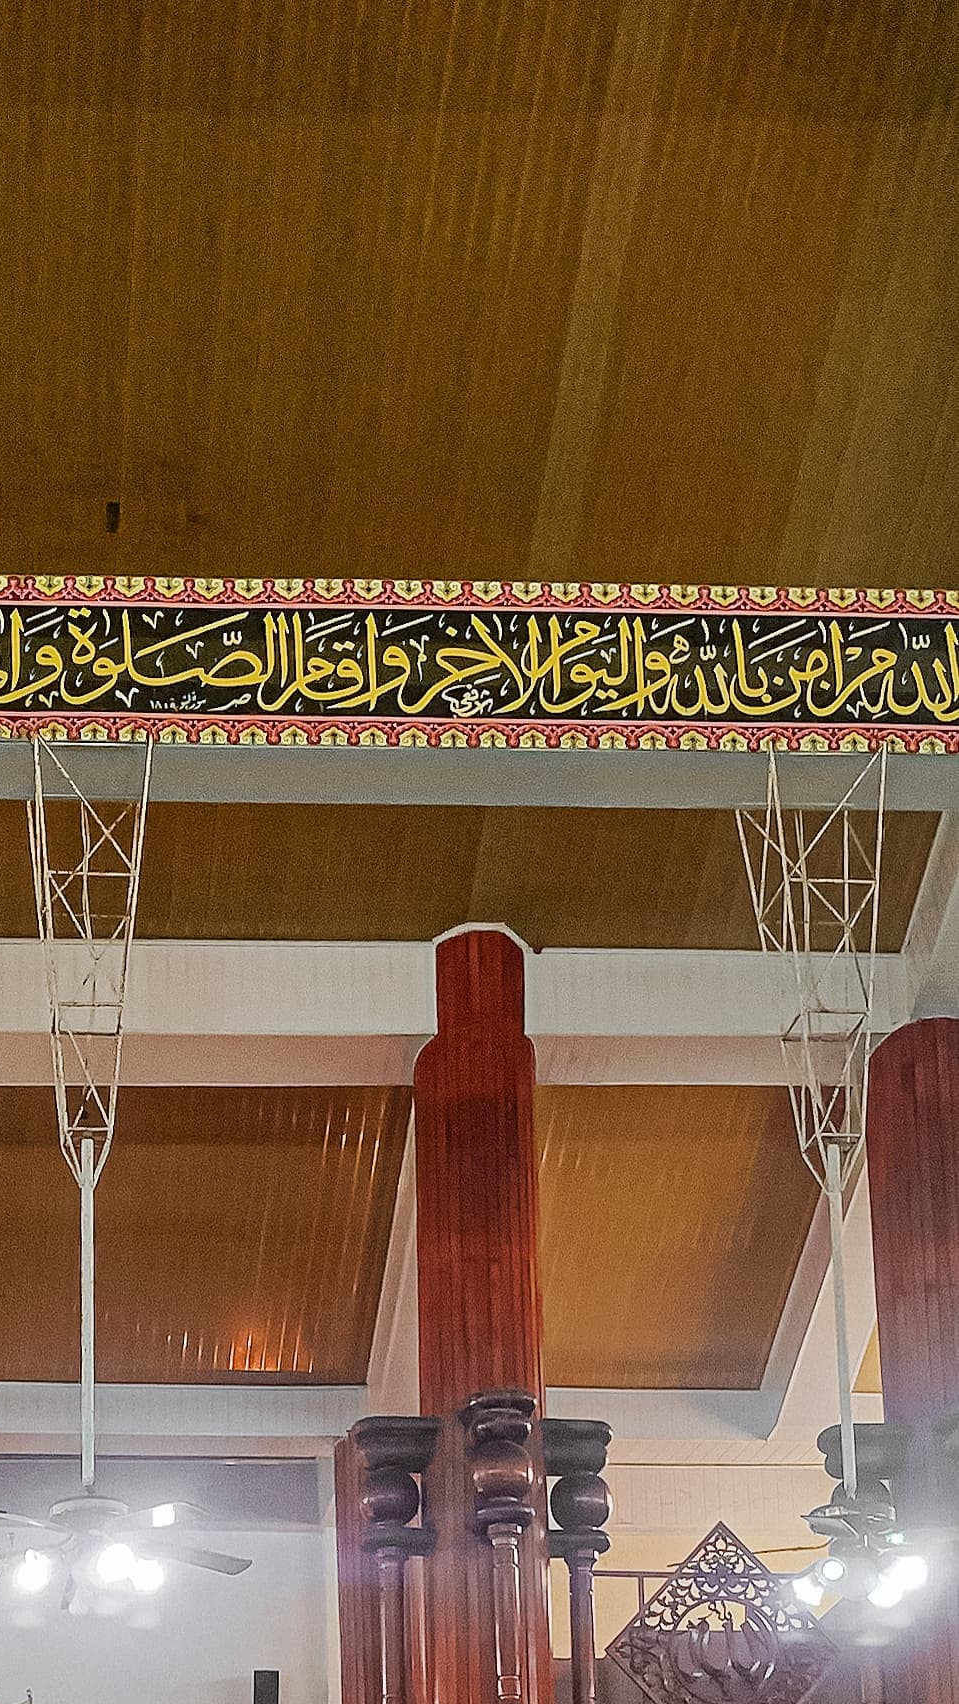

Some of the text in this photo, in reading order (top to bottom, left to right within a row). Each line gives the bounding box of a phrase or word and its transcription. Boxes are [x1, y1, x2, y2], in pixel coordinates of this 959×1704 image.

[524, 616, 672, 714] واليوم
[670, 618, 769, 716] بالله
[806, 649, 898, 717] من
